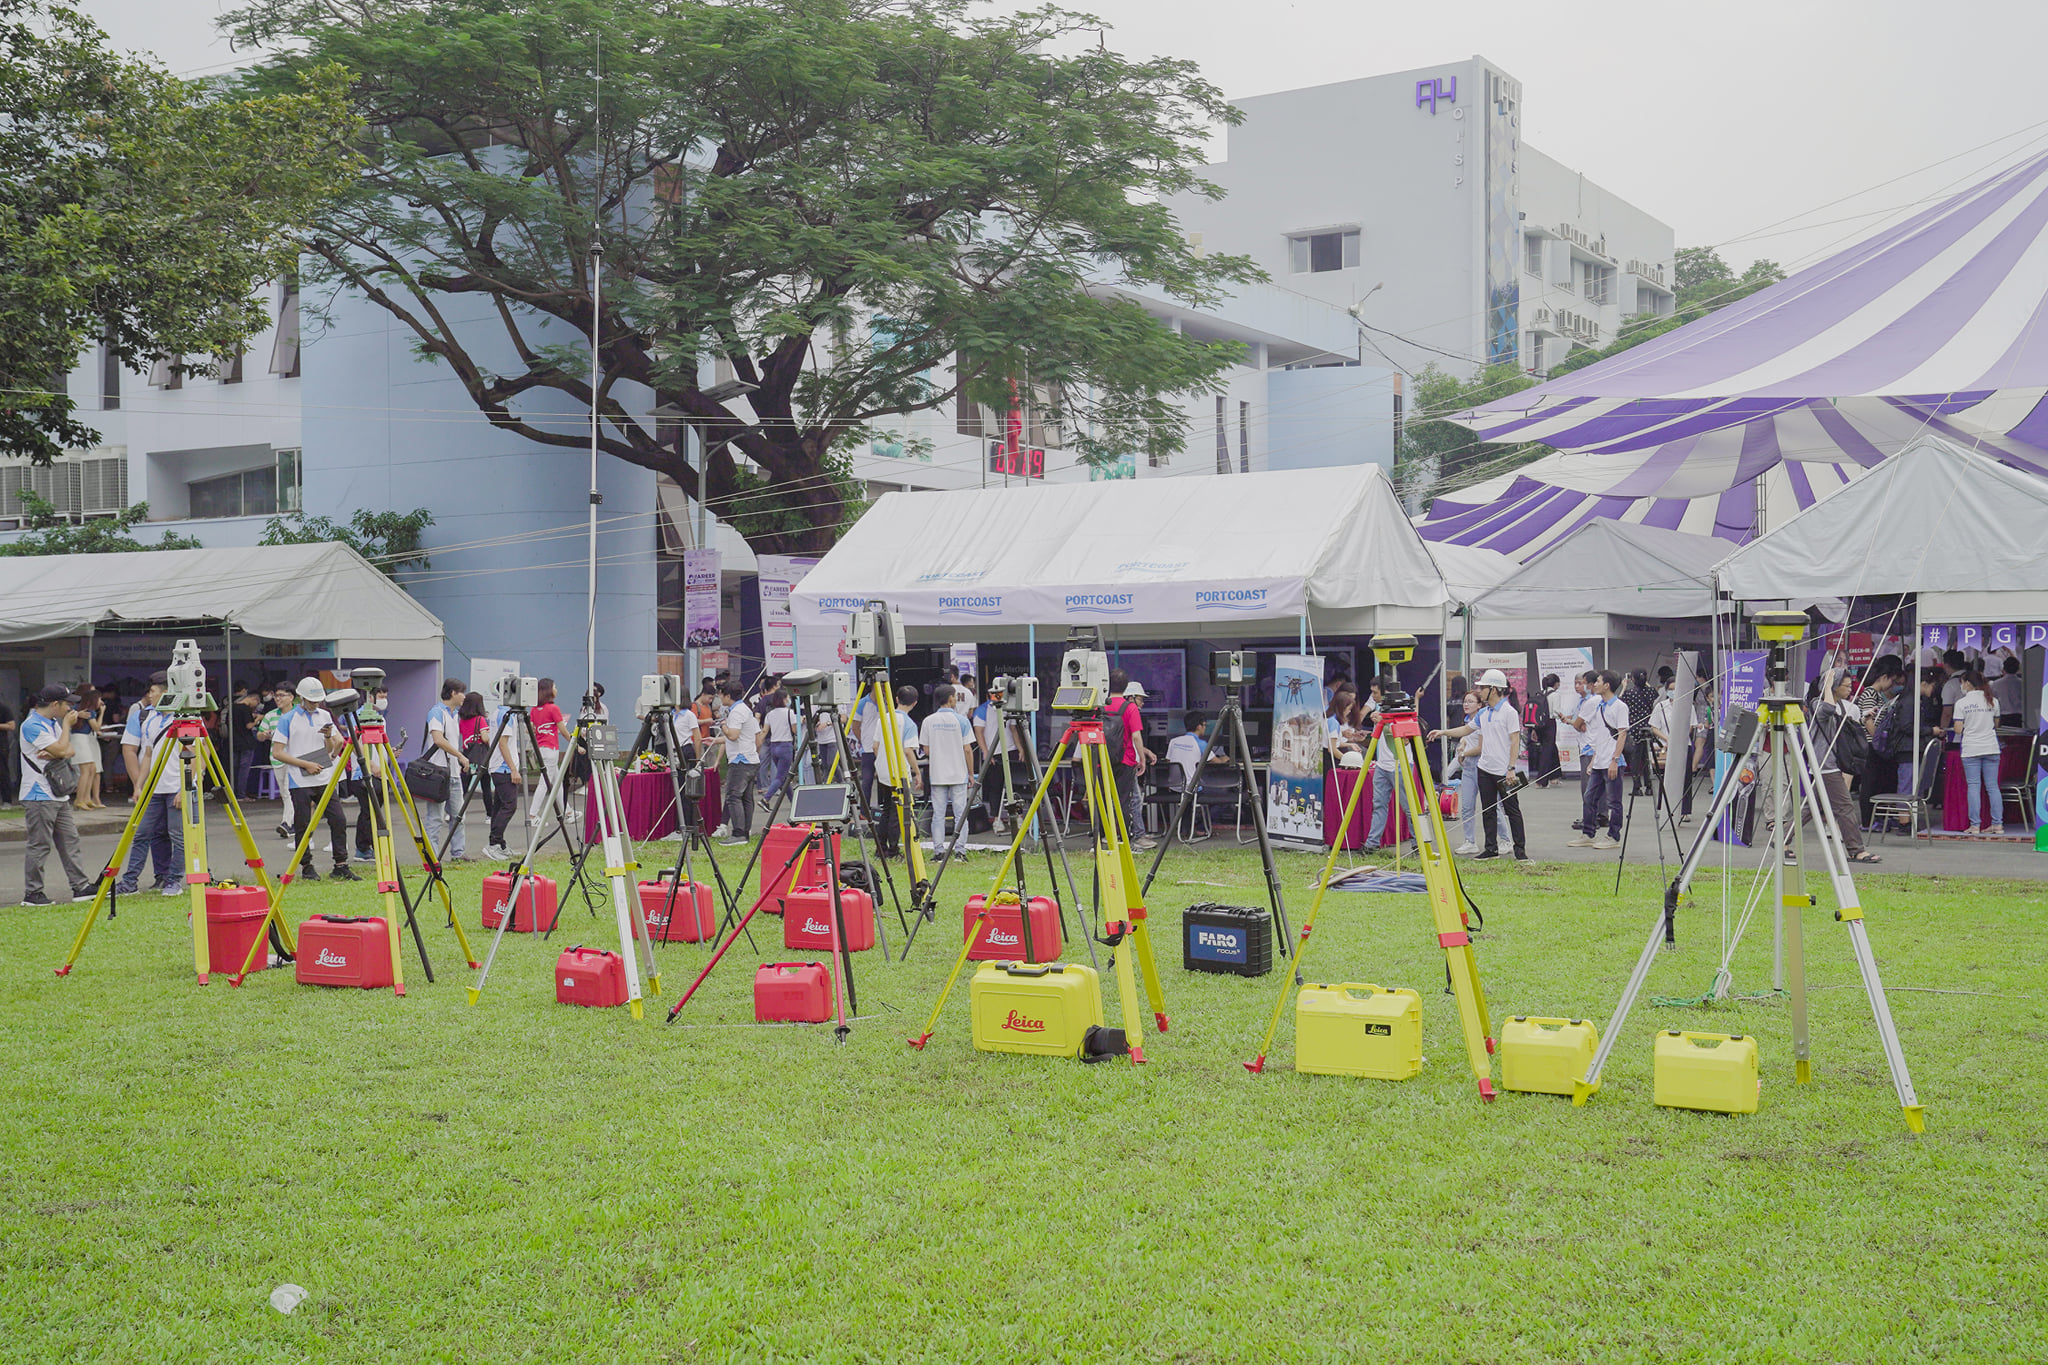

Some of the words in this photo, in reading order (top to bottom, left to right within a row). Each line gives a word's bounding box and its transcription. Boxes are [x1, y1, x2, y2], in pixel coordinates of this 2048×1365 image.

[1416, 76, 1456, 115] A4
[939, 596, 1002, 607] PORTCOAST
[1065, 593, 1134, 606] PORTCOAST
[1195, 589, 1267, 602] PORTCOAST
[493, 899, 508, 915] Lei
[802, 917, 830, 934] Leica
[986, 927, 1019, 946] Leica
[1199, 931, 1236, 948] FARO
[315, 947, 347, 967] Leica
[1001, 1009, 1046, 1033] Leica
[1367, 1023, 1389, 1036] Leica
